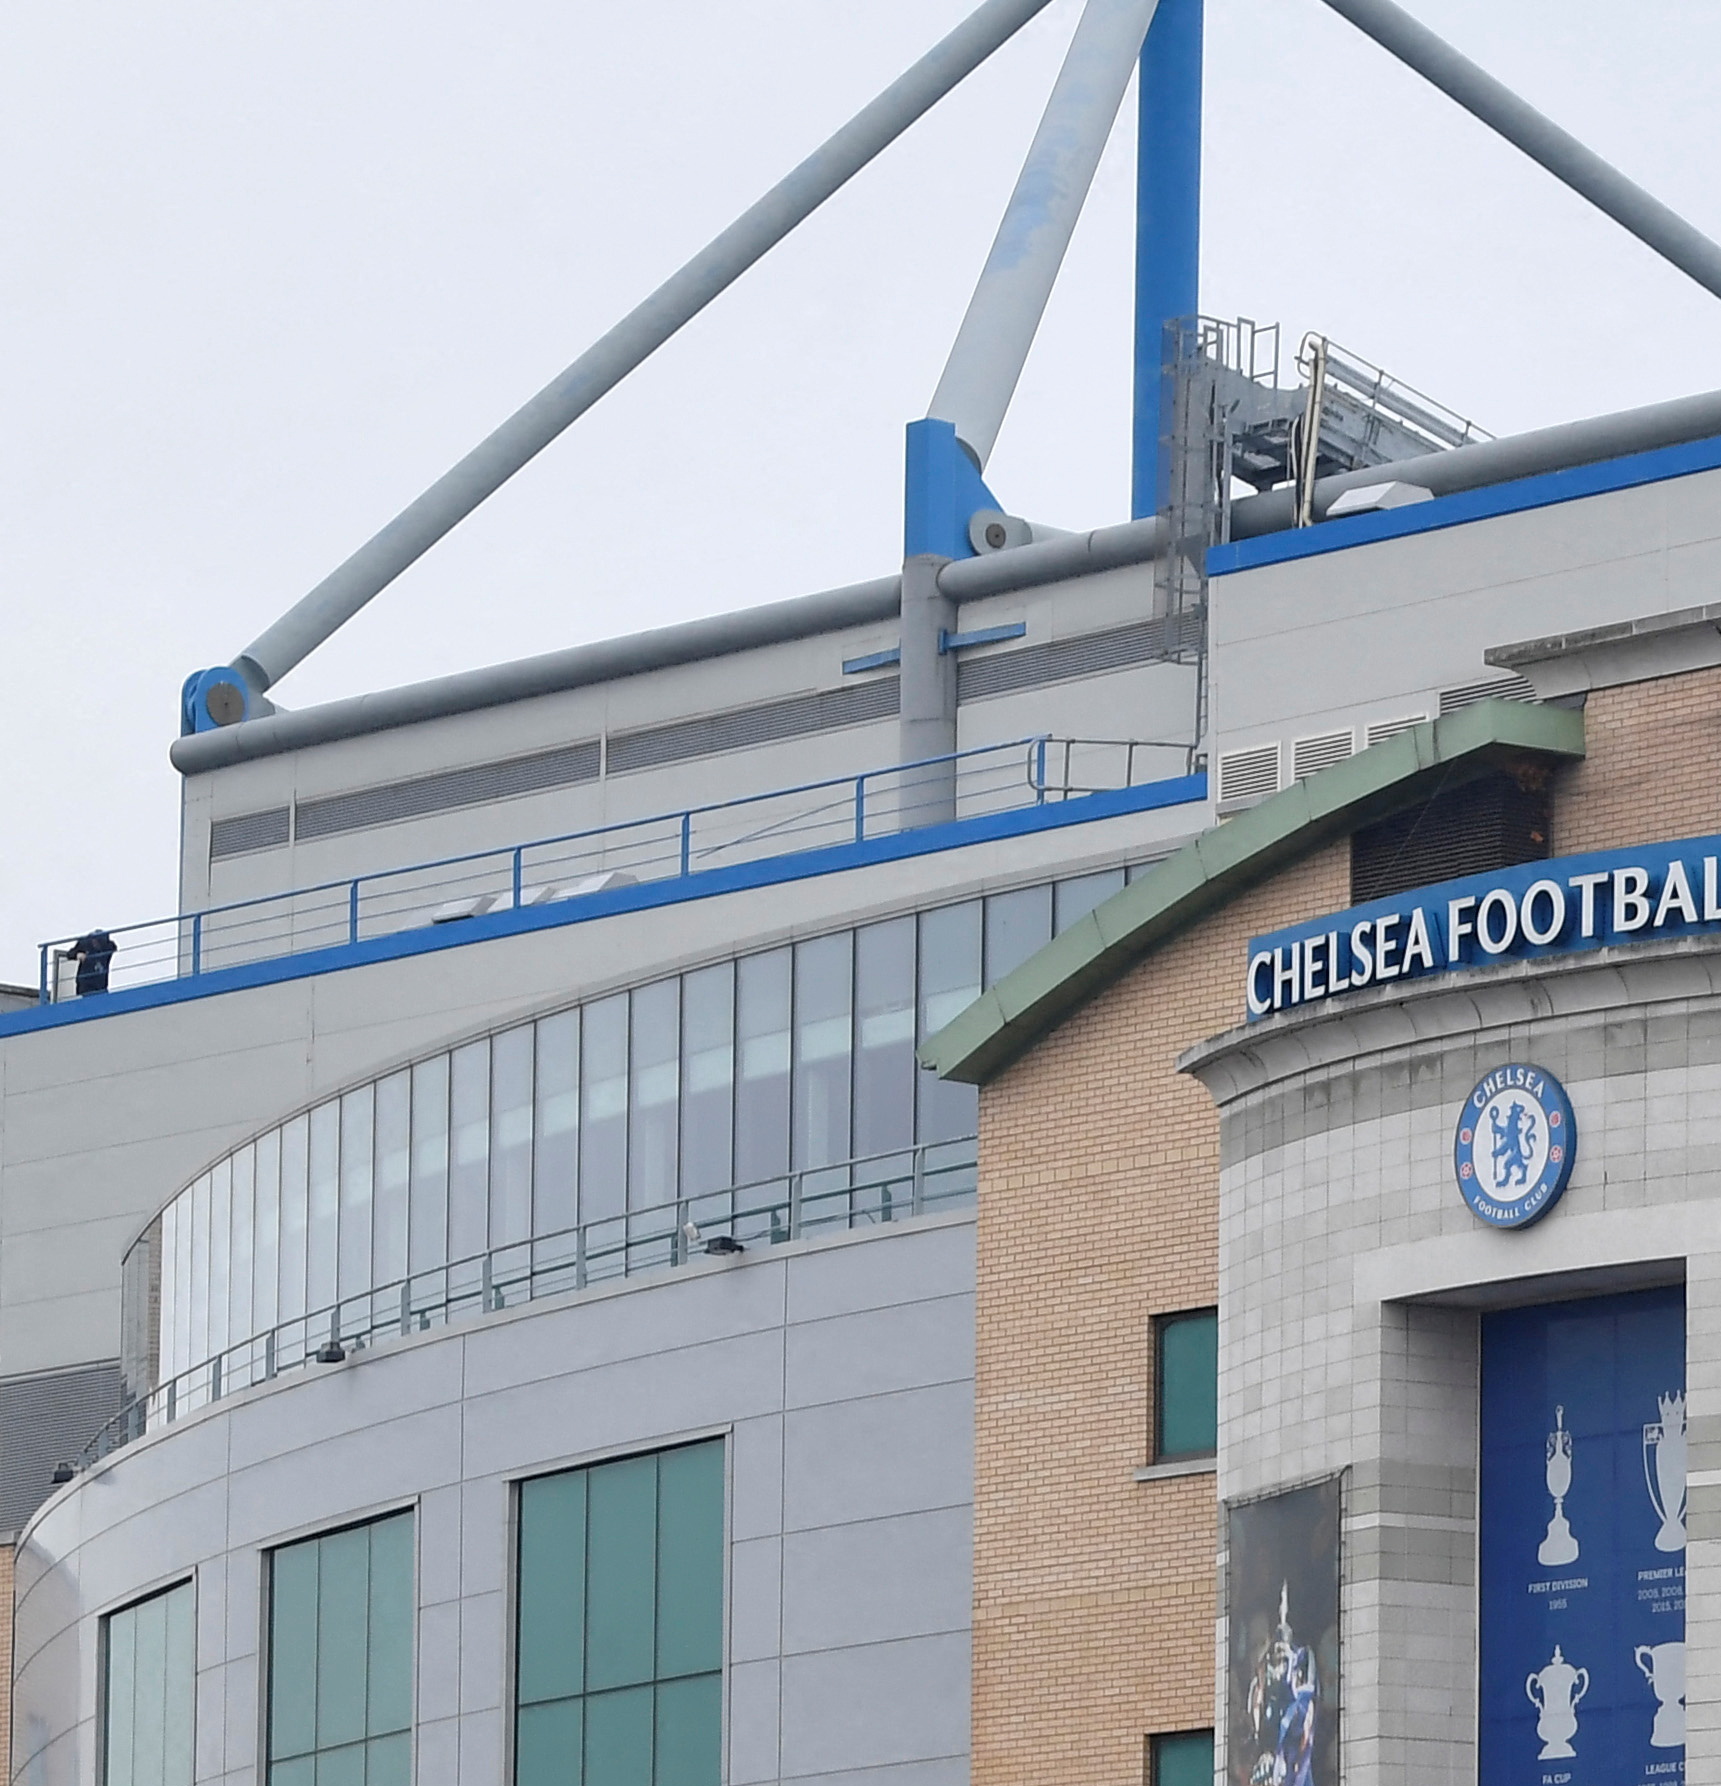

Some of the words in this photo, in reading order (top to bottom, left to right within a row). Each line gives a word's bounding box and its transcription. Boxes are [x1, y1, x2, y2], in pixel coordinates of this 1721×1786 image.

[1246, 905, 1433, 1016] CHELSEA
[1473, 1067, 1545, 1108] CHELSEA
[1473, 1195, 1520, 1220] FOOTBALL
[1524, 1182, 1549, 1212] CLUB
[1637, 1568, 1673, 1581] PREMIER
[1528, 1582, 1550, 1594] FIRST
[1551, 1578, 1589, 1592] DIVISION
[1645, 1763, 1676, 1775] LEAGUE
[1542, 1774, 1552, 1785] FA
[1553, 1773, 1572, 1784] CUP
